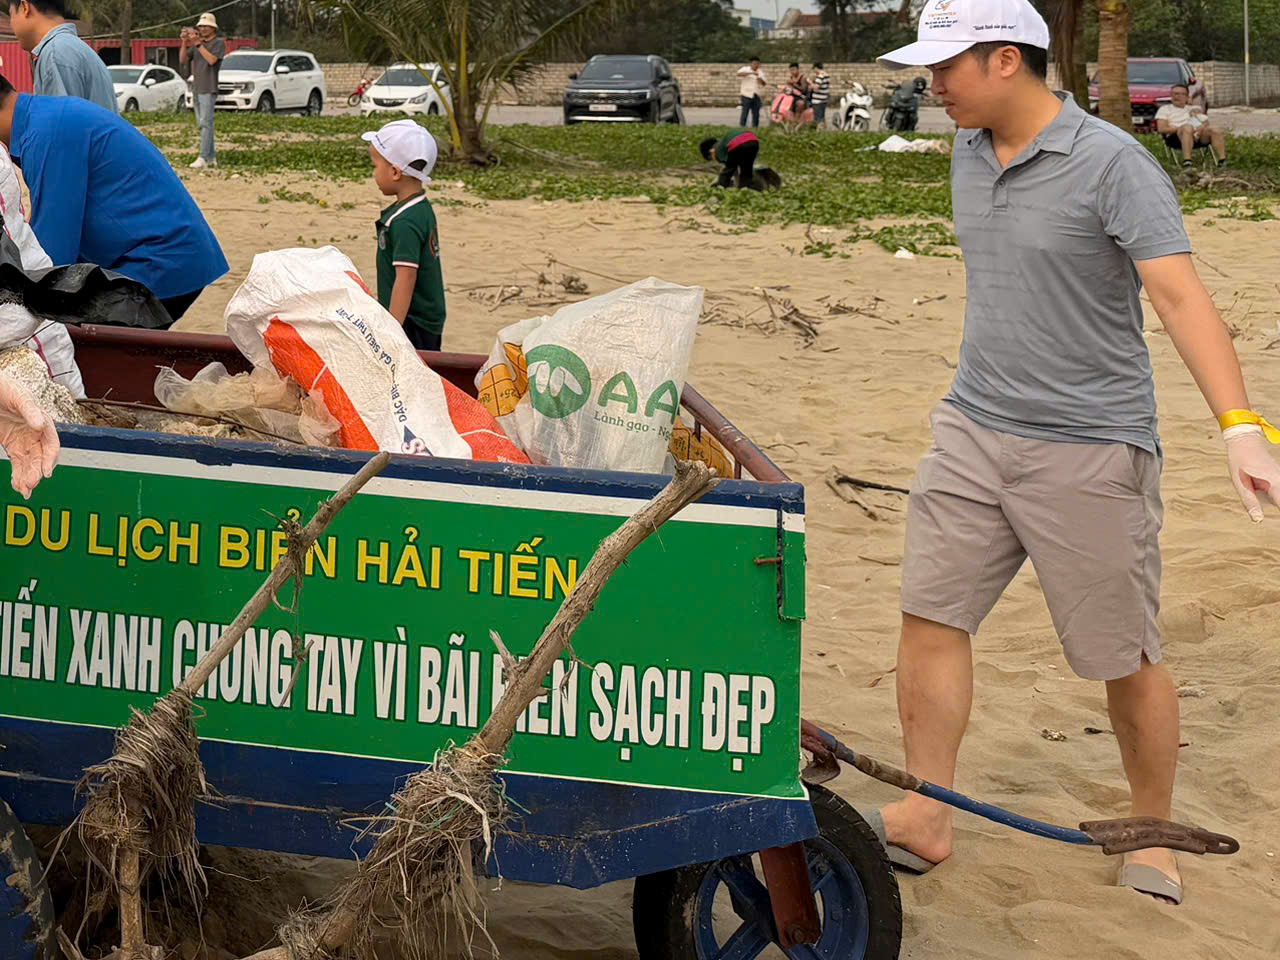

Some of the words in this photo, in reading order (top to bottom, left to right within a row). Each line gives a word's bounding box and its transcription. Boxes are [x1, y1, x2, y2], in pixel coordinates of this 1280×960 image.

[5, 505, 70, 551] DU
[87, 513, 199, 567] LỊCH
[356, 526, 441, 590] HẢI
[459, 537, 577, 599] TIẾN
[66, 609, 162, 693] XANH
[304, 632, 363, 715] TAY
[374, 627, 407, 721] VÌ
[418, 634, 480, 728] BÃI
[492, 653, 578, 737] BN
[589, 662, 692, 761] SẠCH
[701, 671, 776, 771] ĐẸP
